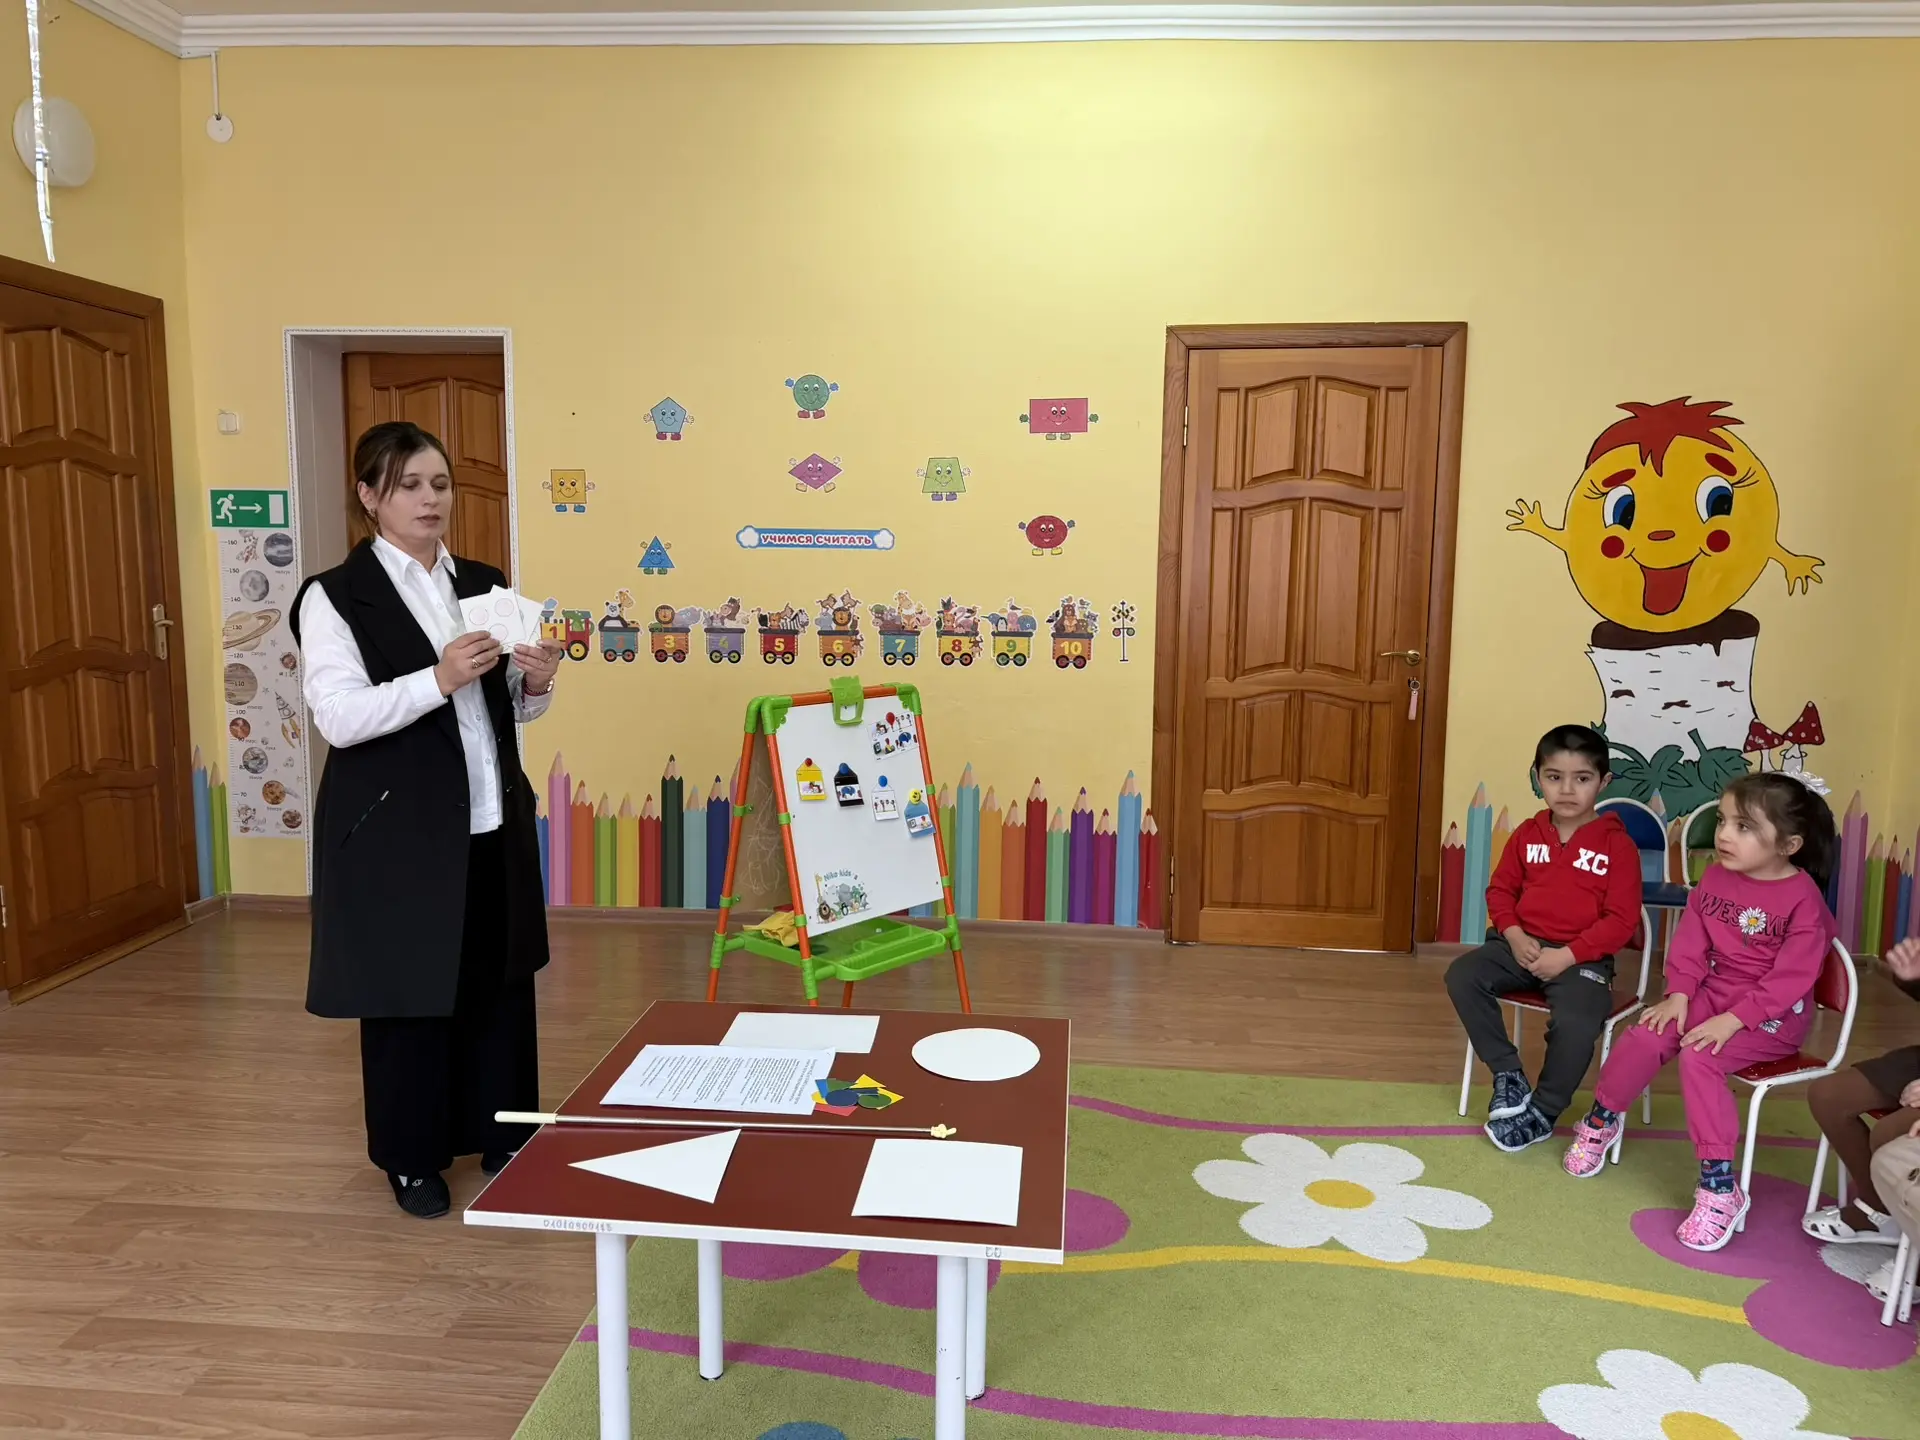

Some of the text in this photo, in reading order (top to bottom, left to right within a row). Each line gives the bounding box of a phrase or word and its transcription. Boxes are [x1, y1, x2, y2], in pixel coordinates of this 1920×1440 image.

[762, 534, 872, 545] УЧИМСЯ СЧИТАТЬ
[549, 626, 557, 639] 1
[664, 634, 676, 649] 3
[718, 636, 729, 648] 4
[774, 638, 785, 651] 5
[832, 639, 843, 652] 6
[895, 639, 906, 652] 7
[951, 639, 962, 652] 8
[1005, 640, 1017, 652] 9
[1060, 641, 1082, 654] 10
[1573, 847, 1609, 876] XC
